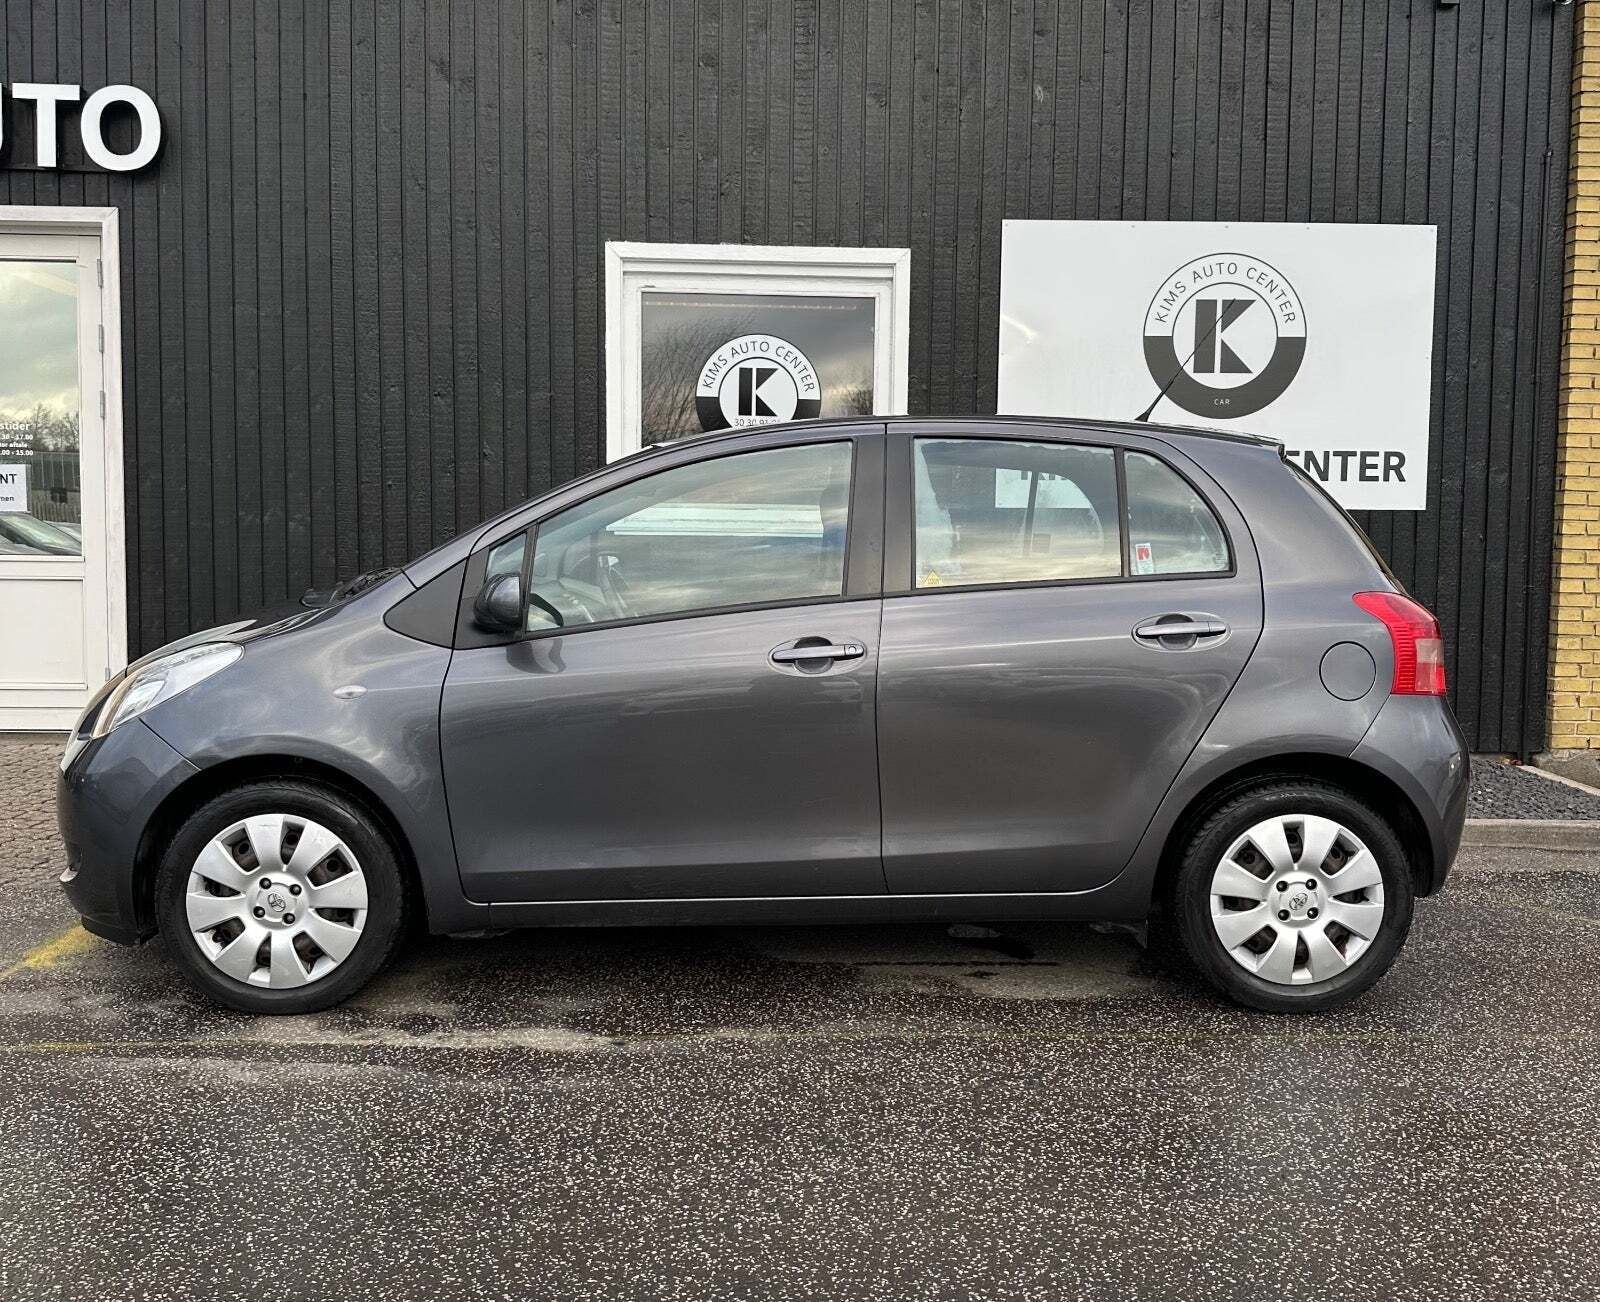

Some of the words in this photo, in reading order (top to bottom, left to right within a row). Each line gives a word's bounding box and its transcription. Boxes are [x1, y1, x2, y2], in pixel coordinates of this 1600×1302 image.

[0, 82, 161, 171] TO
[1155, 281, 1187, 323] KIMS
[1192, 263, 1238, 283] AUTO
[1246, 267, 1296, 324] CENTER
[702, 354, 728, 389] KIMS
[730, 341, 770, 358] AUTO
[775, 346, 815, 393] CENTER
[1286, 450, 1406, 482] NTER
